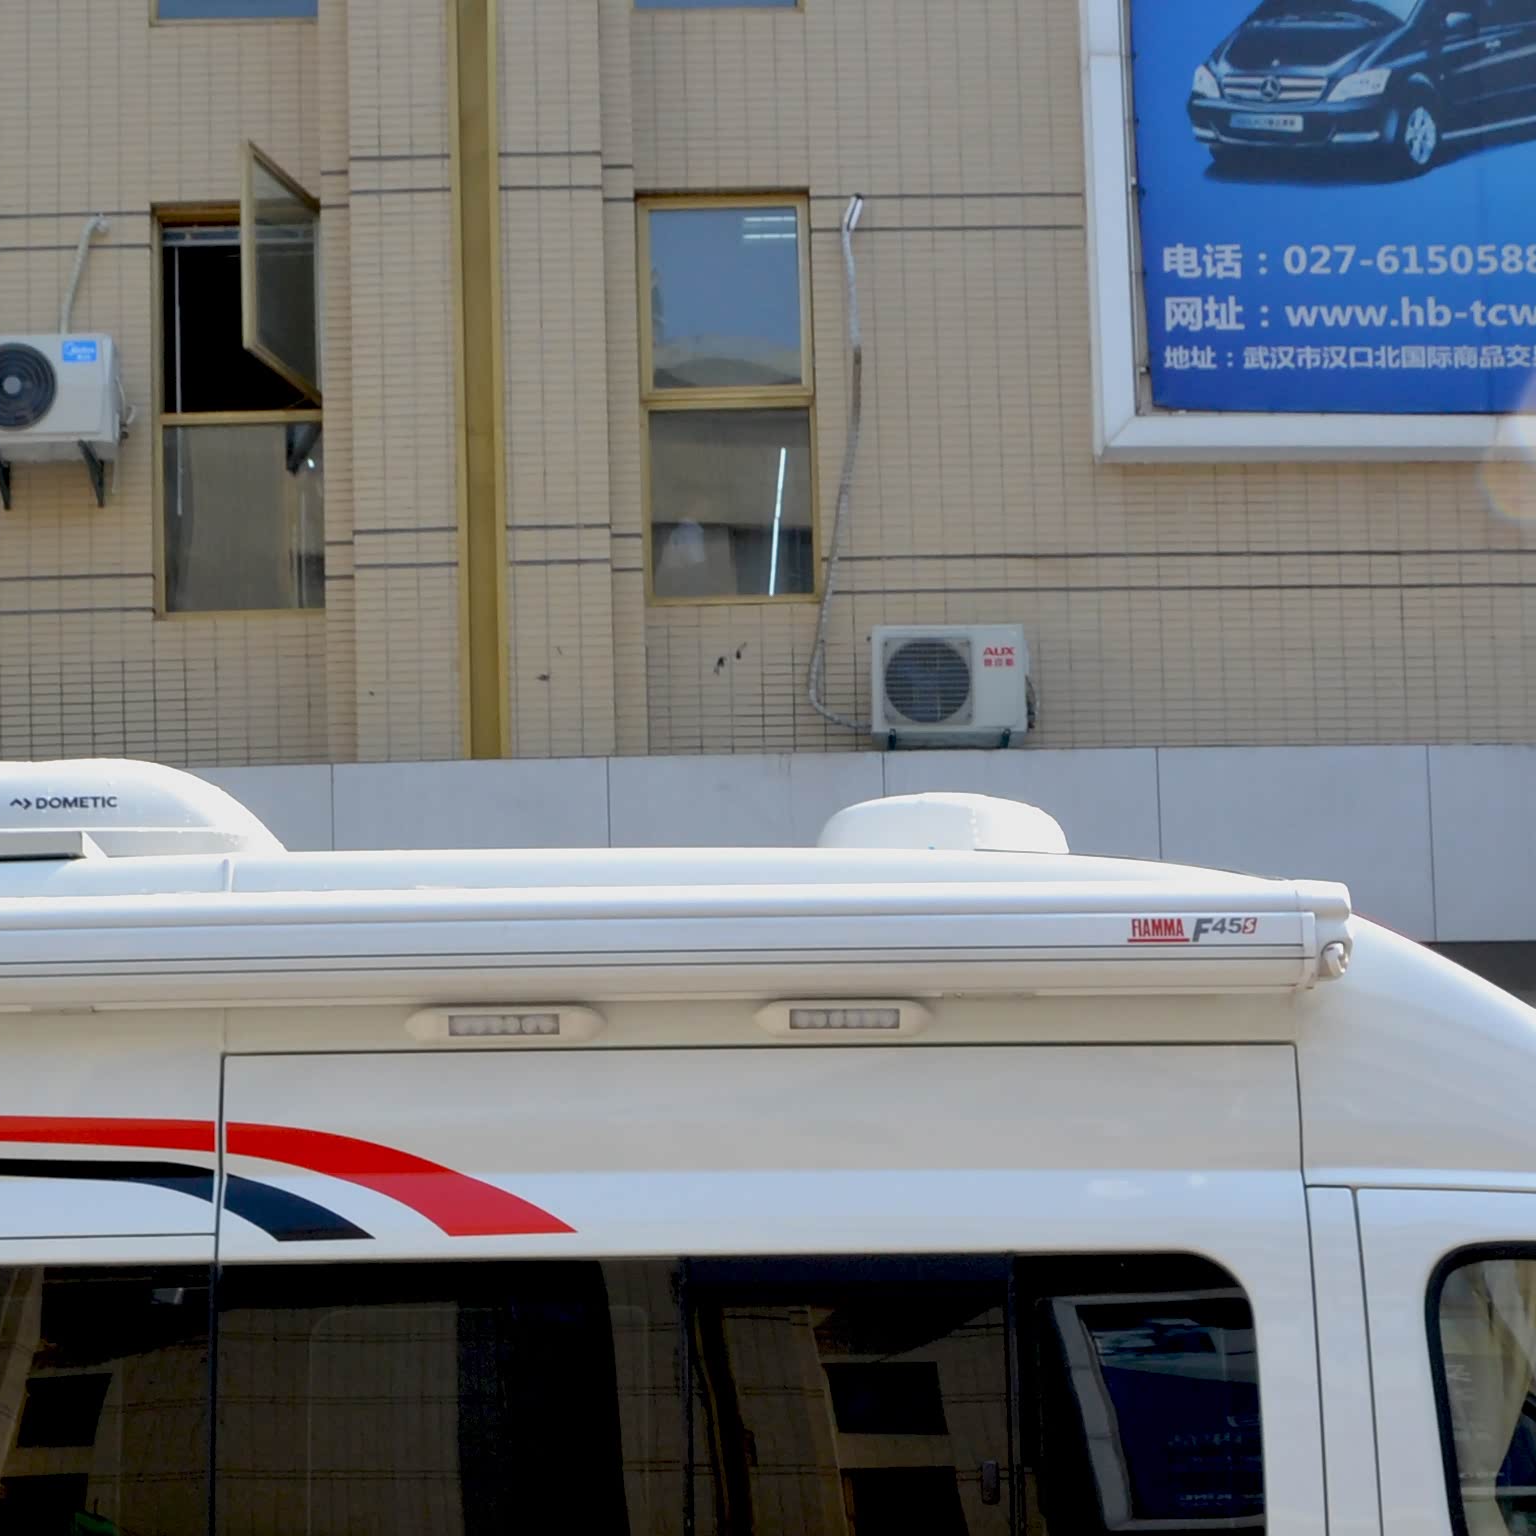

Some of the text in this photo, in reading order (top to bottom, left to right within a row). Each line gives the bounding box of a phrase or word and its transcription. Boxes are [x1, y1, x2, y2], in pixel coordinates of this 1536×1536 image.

[983, 647, 1016, 656] AUX
[35, 796, 119, 810] DOMETIC
[1131, 917, 1258, 943] FIAMMA F45S
